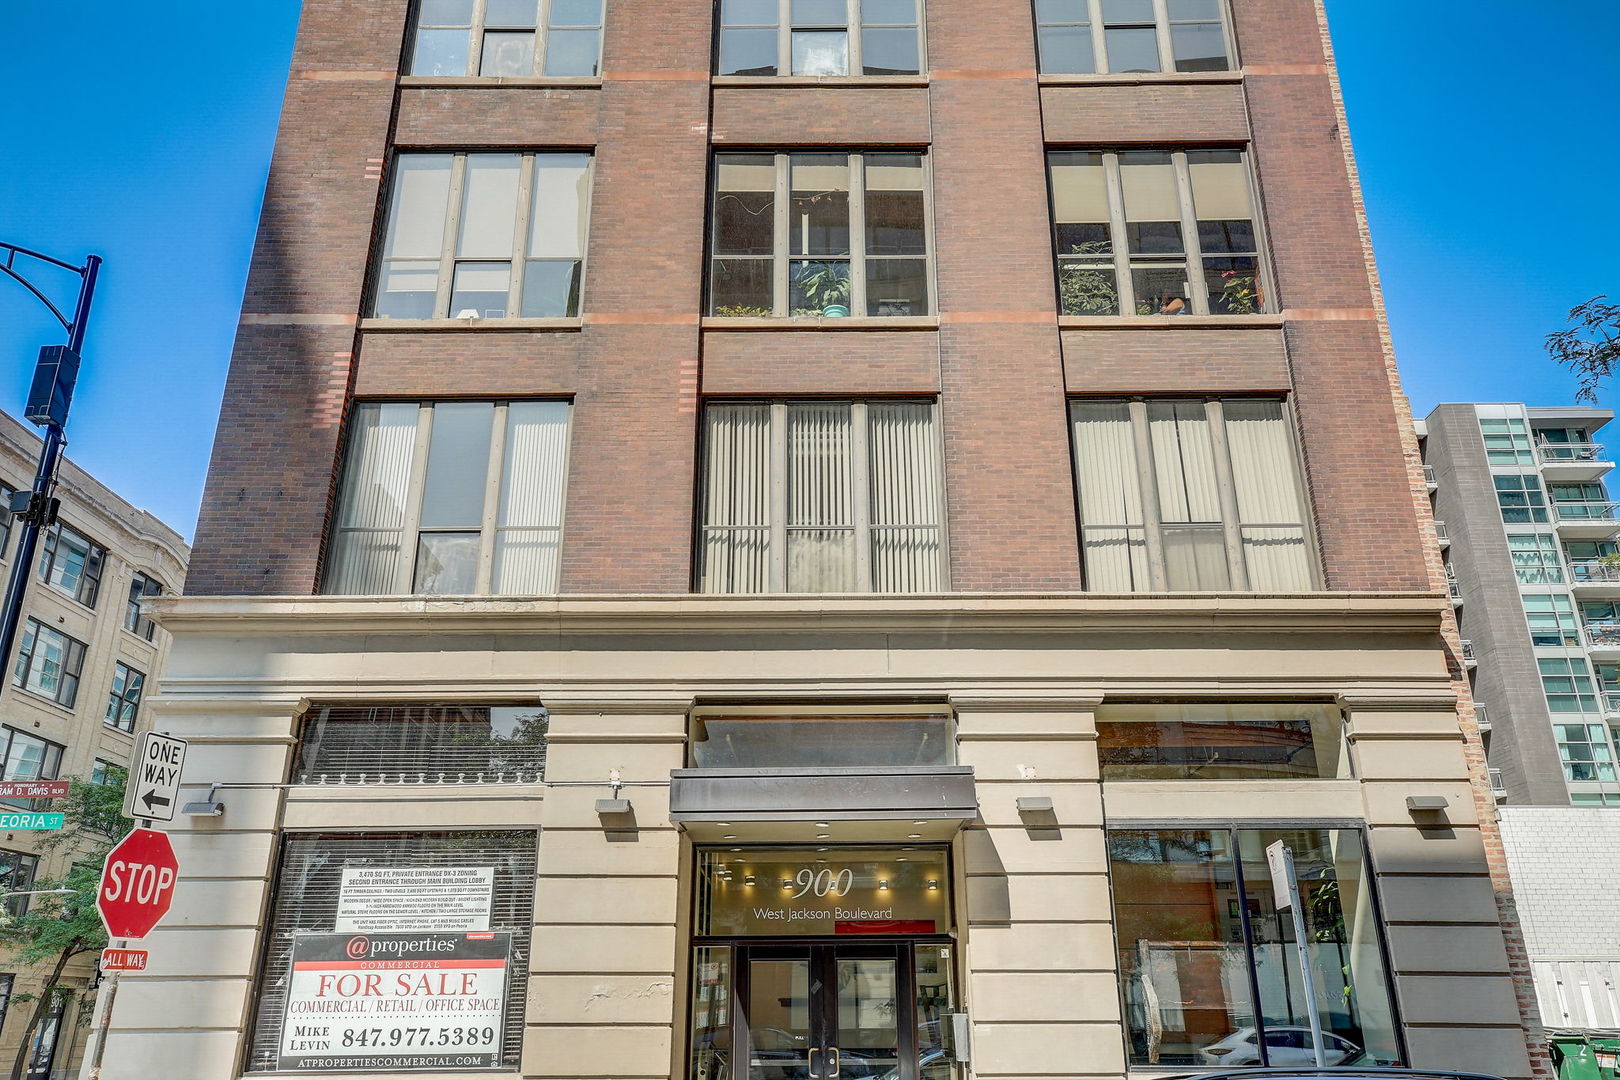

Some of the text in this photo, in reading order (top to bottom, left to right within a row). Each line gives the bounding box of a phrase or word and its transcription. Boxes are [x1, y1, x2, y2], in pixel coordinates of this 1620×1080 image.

[150, 742, 180, 765] ONE
[145, 764, 177, 786] WAY
[0, 815, 45, 827] EORIA
[105, 860, 173, 905] STOP
[792, 868, 853, 899] 900
[753, 907, 893, 922] West Jackson Boulevard
[107, 953, 144, 967] ALL WAY
[316, 972, 478, 997] FOR SALE
[291, 1000, 366, 1013] COMMERCIAL
[377, 1000, 416, 1012] RETAIL
[426, 999, 465, 1011] OFFICE
[467, 998, 500, 1011] SPACE
[295, 1026, 330, 1037] MIKE
[342, 1027, 494, 1048] 847.977.5389
[290, 1039, 330, 1051] LEVIN
[1579, 1045, 1587, 1056] 2
[297, 1056, 482, 1068] ATPROPERTIESCOMMERCIAL.COM
